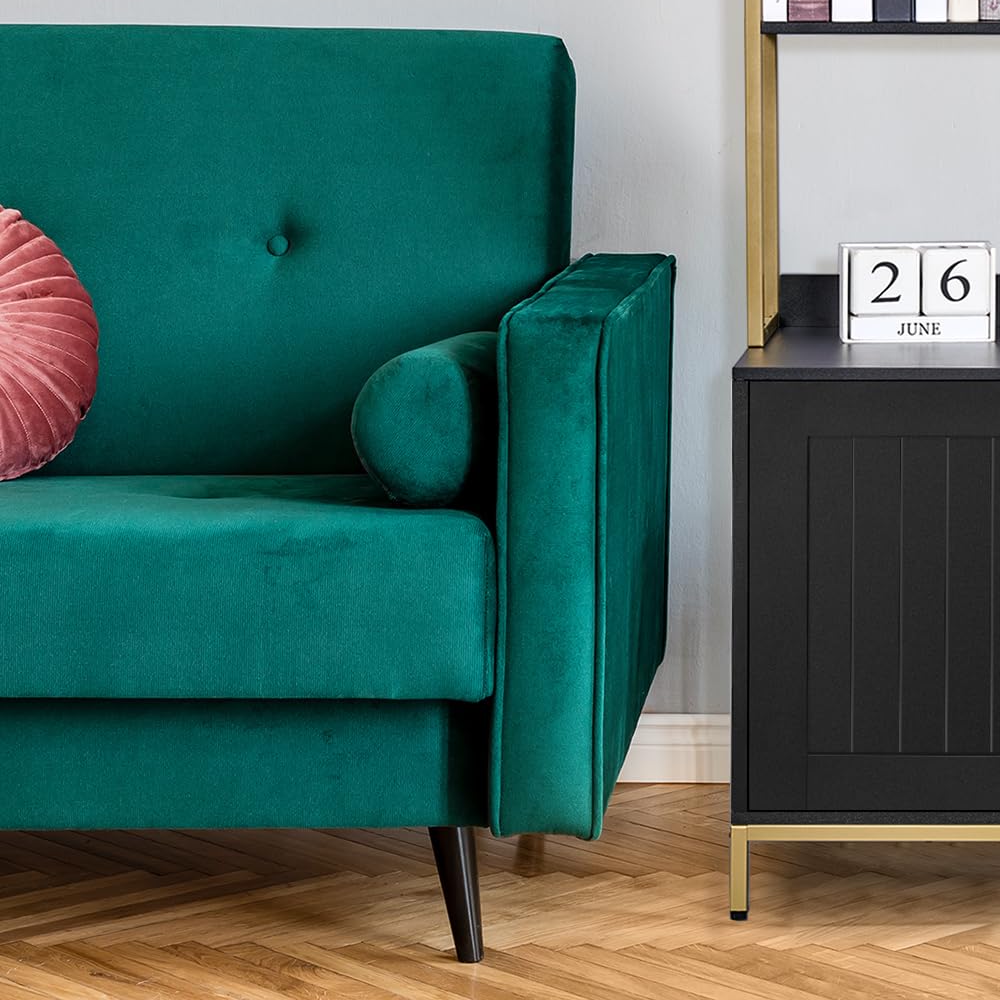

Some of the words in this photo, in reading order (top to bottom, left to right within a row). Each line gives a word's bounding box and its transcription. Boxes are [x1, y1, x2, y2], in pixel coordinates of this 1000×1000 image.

[871, 261, 902, 304] 2
[940, 258, 971, 302] 6
[897, 322, 942, 336] JUNE
